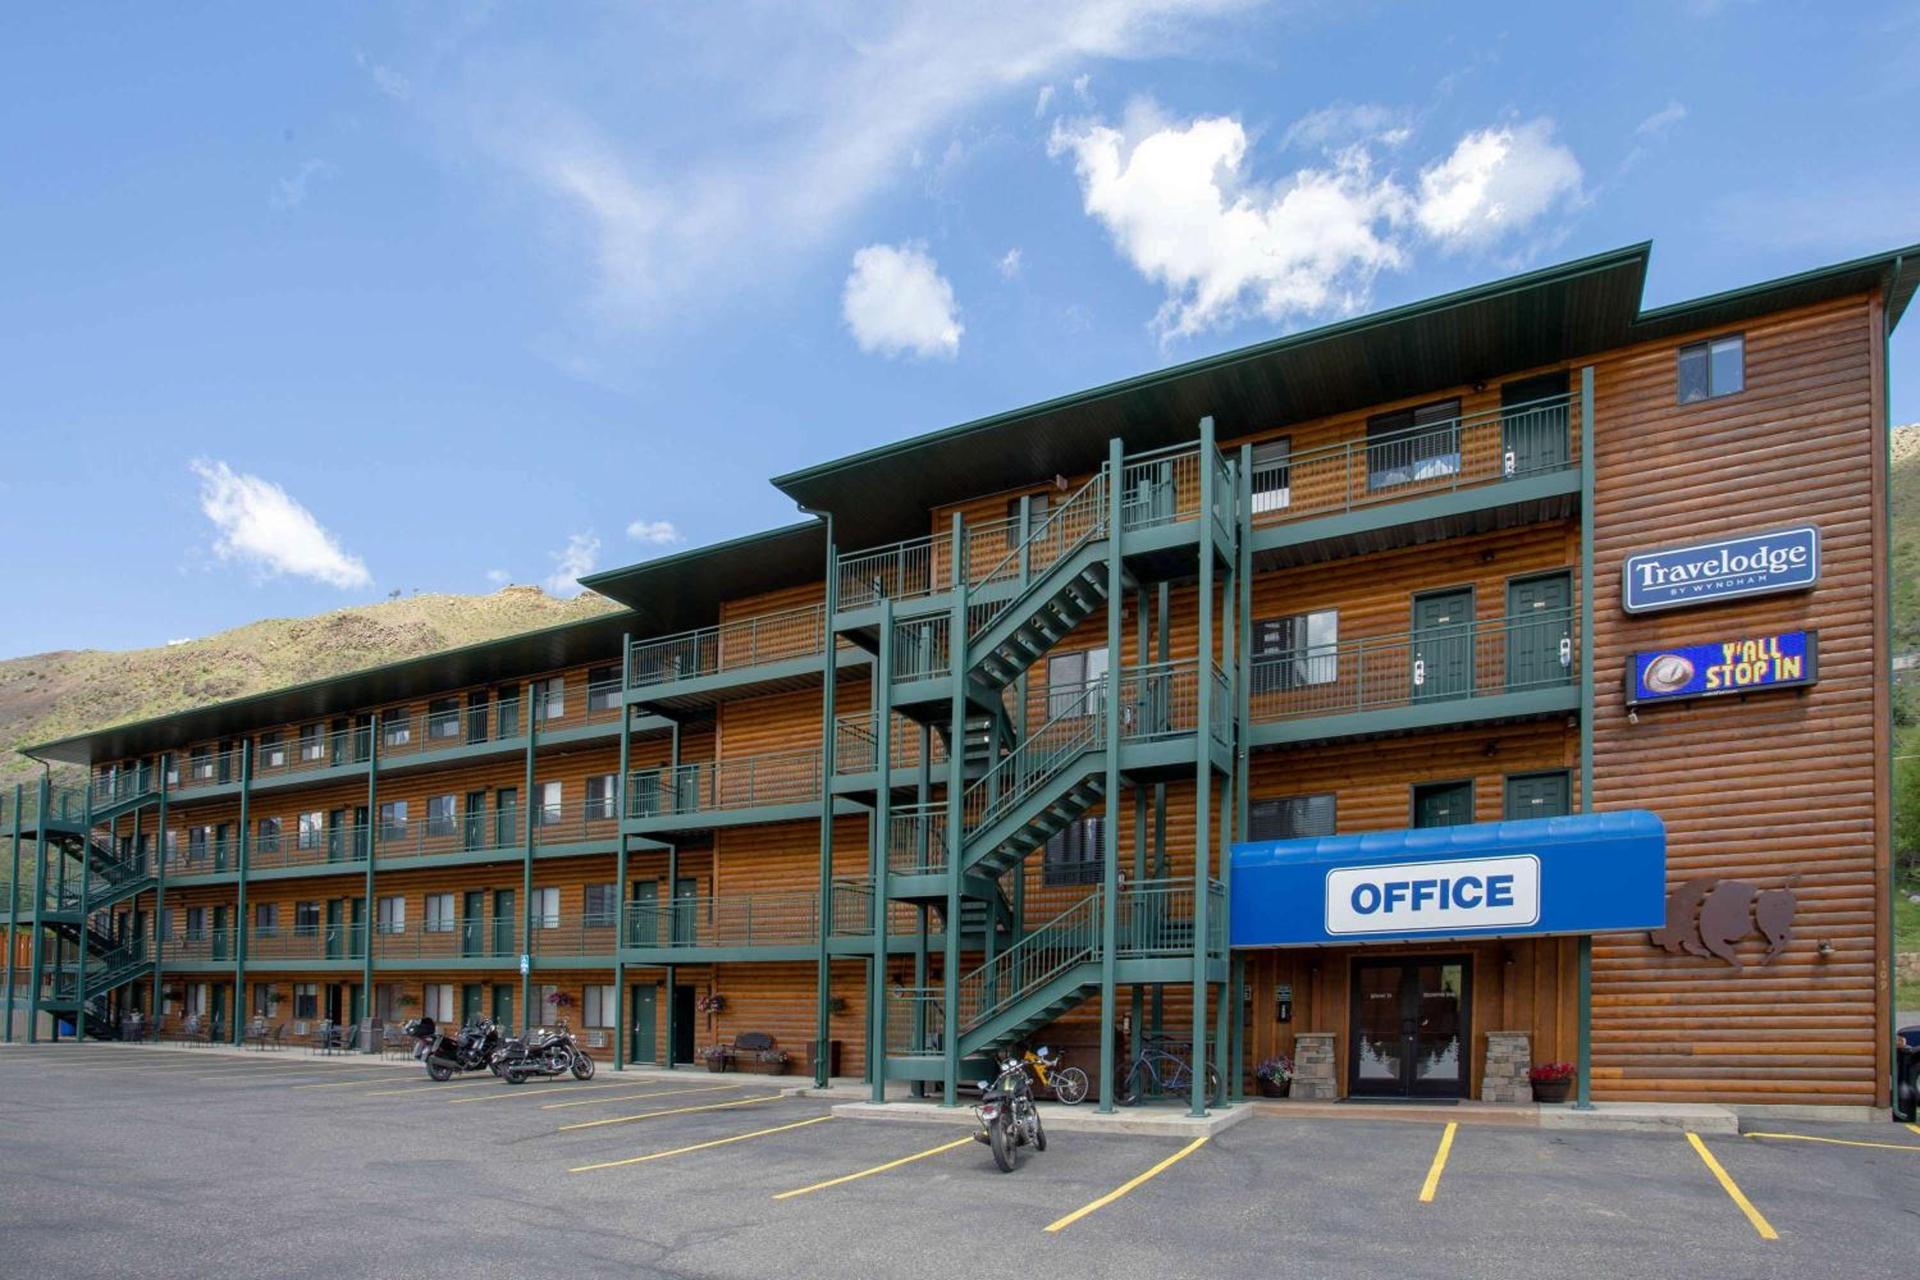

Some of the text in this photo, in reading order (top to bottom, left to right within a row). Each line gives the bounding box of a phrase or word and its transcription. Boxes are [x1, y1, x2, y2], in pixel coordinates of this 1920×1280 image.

[1636, 545, 1807, 586] Travelodge
[1670, 575, 1767, 596] BY WYNDHAM
[1723, 637, 1781, 665] Y'ALL
[1706, 656, 1801, 688] STOP IN
[1351, 874, 1514, 915] OFFICE
